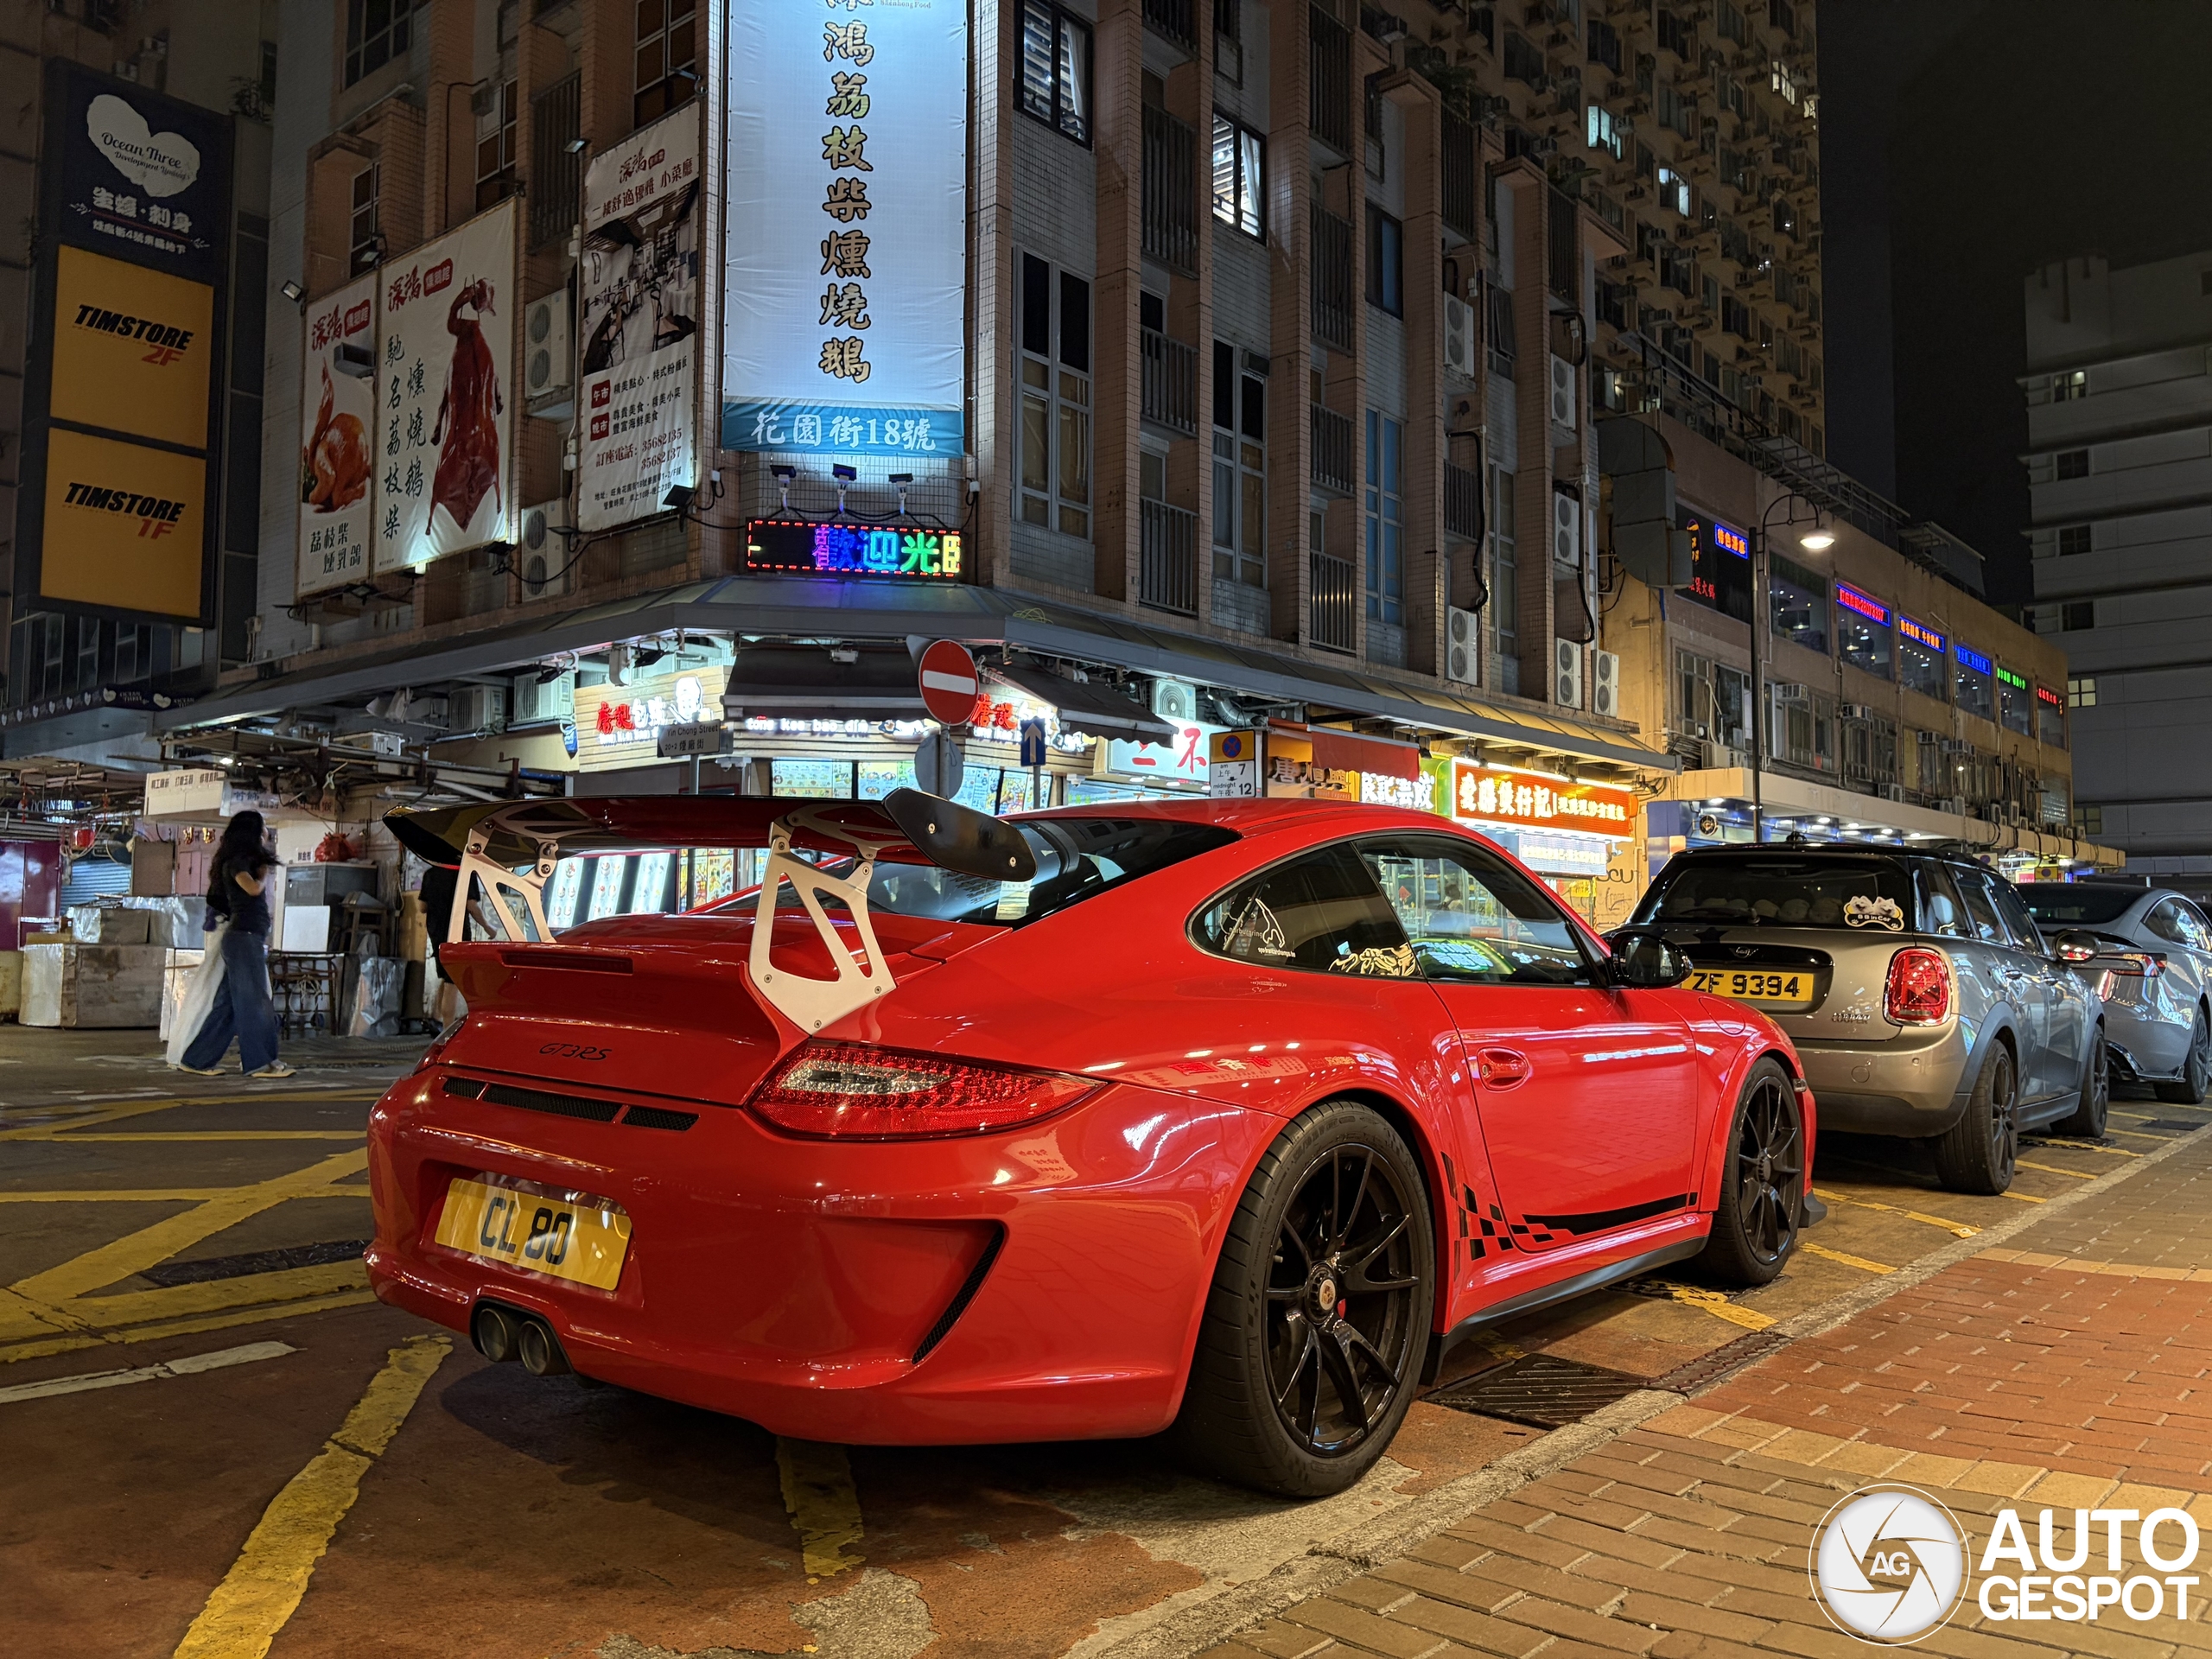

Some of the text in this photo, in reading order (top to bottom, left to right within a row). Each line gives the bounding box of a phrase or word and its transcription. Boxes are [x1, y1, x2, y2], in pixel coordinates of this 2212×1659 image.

[102, 132, 181, 168] Ocean Three
[115, 151, 159, 171] Development
[74, 304, 194, 351] TIMSTORE
[141, 345, 184, 366] 2F
[593, 387, 609, 402] 午市
[383, 334, 405, 540] 馳名荔枝柴
[592, 419, 608, 434] 晚市
[751, 411, 936, 451] 花園街18號
[642, 429, 682, 451] 35682135
[640, 447, 681, 471] 35682137
[65, 482, 186, 522] TIMSTORE
[137, 519, 175, 539] 1F
[309, 523, 349, 554] 荔枝柴
[667, 728, 677, 737] Yin
[677, 727, 697, 737] Chong
[699, 725, 718, 734] Street
[779, 718, 805, 732] kee
[812, 718, 838, 734] bao
[1238, 764, 1246, 776] 7
[1238, 783, 1252, 796] 12
[1692, 972, 1801, 997] ZF 9394
[539, 1042, 613, 1062] GT3RS
[480, 1196, 575, 1266] CL 80
